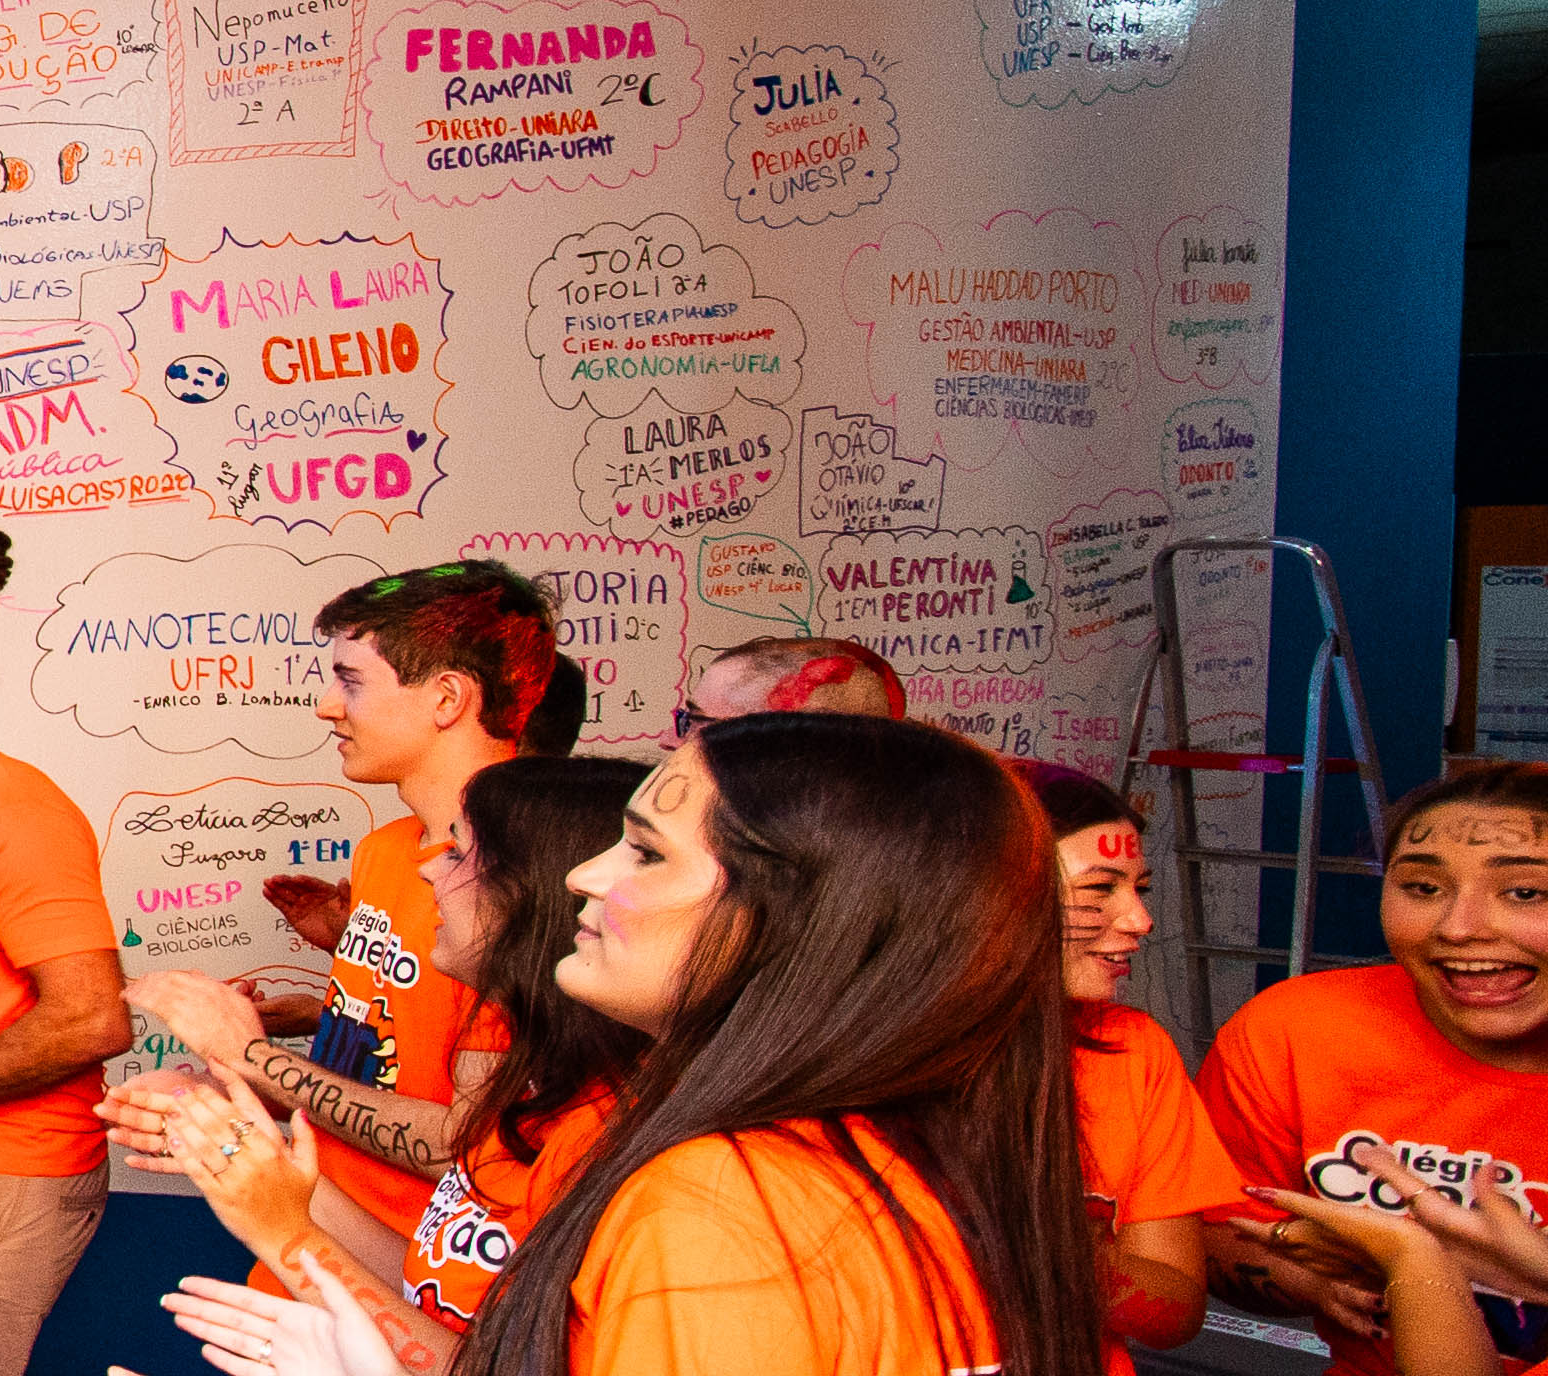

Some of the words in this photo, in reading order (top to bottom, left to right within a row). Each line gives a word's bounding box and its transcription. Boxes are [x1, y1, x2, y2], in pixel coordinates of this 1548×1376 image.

[39, 10, 101, 46] DE
[405, 22, 657, 73] FERNANDA
[769, 158, 856, 204] UNESP
[577, 236, 684, 275] JOÃO
[170, 275, 318, 333] MARIA
[330, 261, 429, 309] LAURA
[889, 273, 967, 307] MALU
[973, 270, 1043, 304] HADDAD
[1047, 271, 1119, 313] PORTO
[919, 314, 984, 342] GESTÃO
[262, 322, 420, 384] GILENO
[625, 413, 727, 454] LAURA
[267, 452, 412, 504] UFGD
[670, 435, 772, 481] MERLOS
[642, 471, 746, 519] UNESP
[170, 655, 255, 692] UFRJ
[136, 880, 243, 914] UNESP
[147, 930, 252, 957] BIOLÓGICAS
[156, 915, 239, 937] CIÊNCIAS
